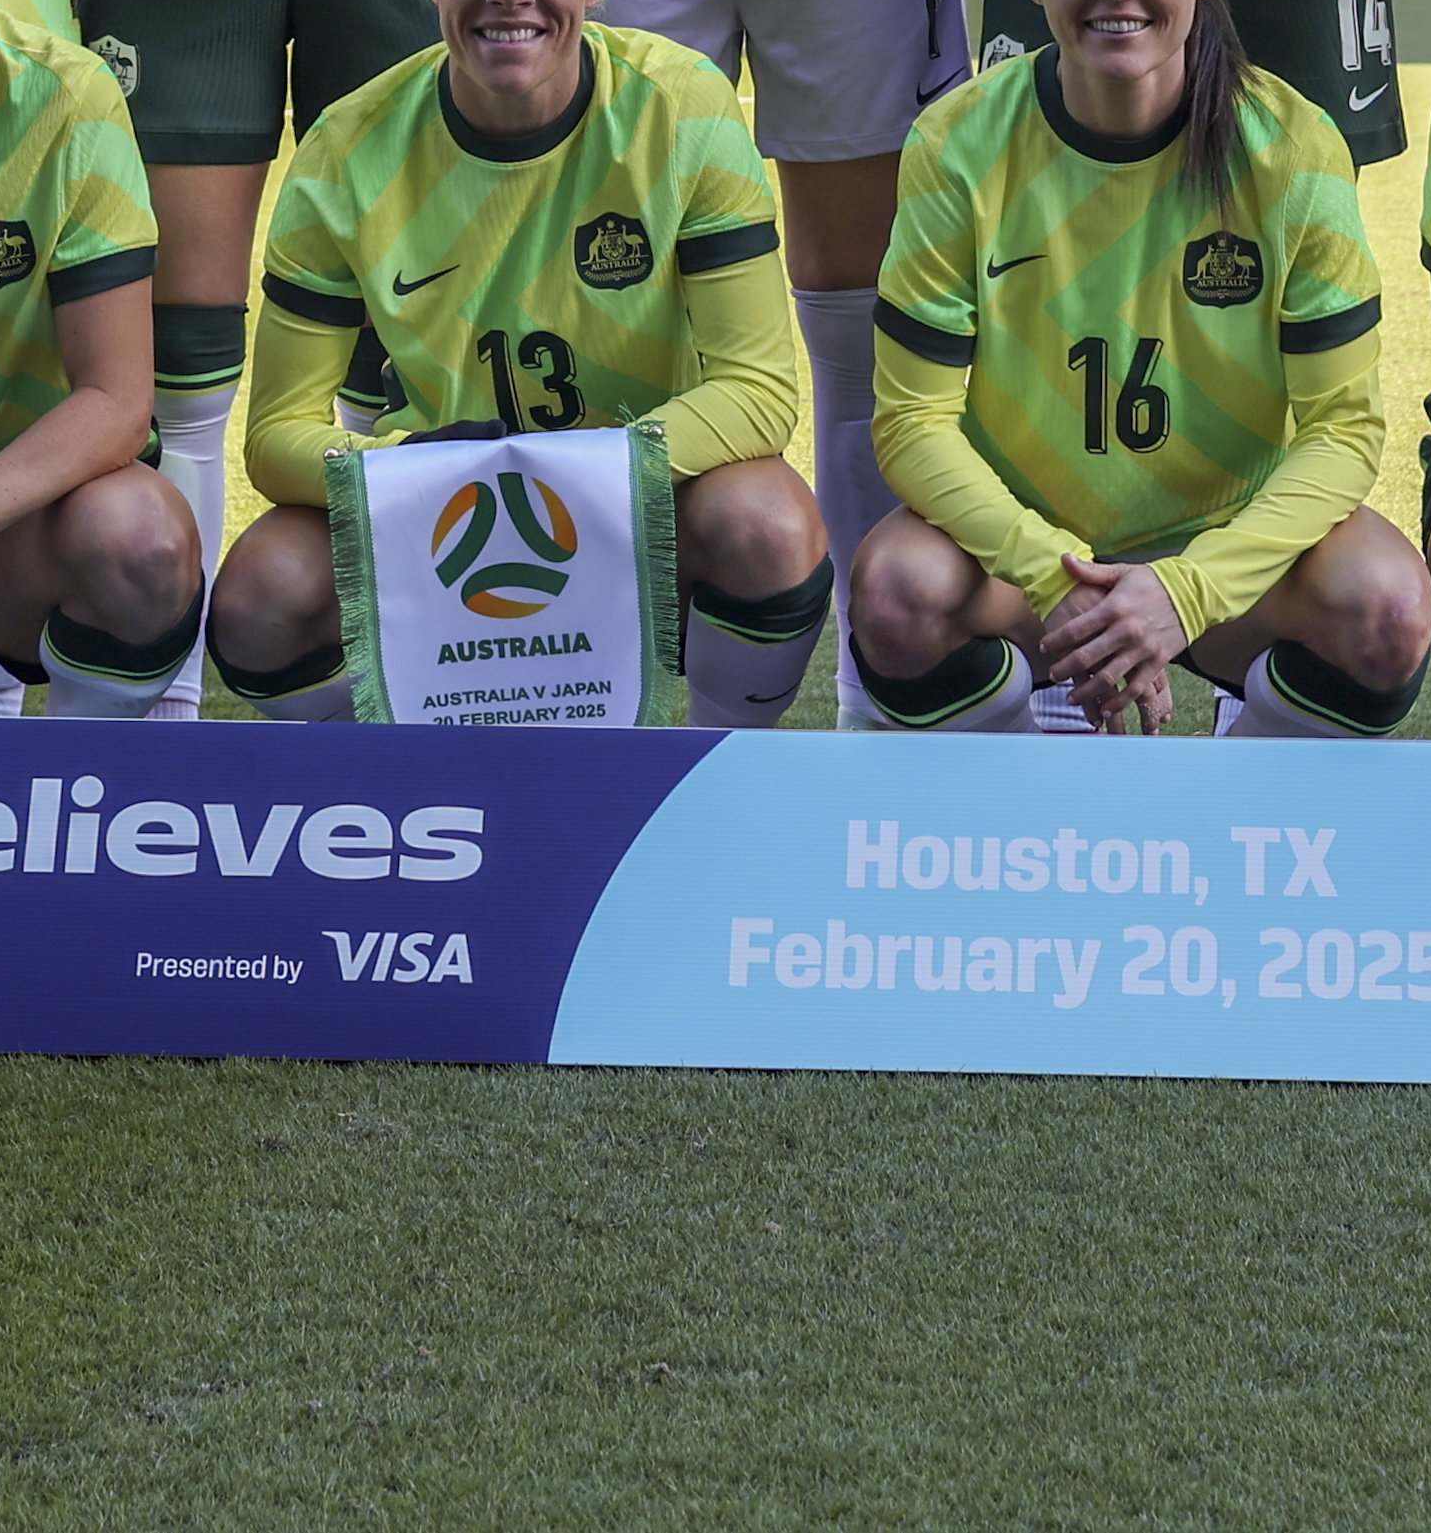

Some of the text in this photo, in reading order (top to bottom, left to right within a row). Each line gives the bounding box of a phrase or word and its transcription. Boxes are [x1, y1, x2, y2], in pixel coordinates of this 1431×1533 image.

[591, 258, 641, 271] AUSTRALIA
[1196, 279, 1249, 288] AUSTRALIA
[477, 329, 586, 436] 13
[1069, 337, 1170, 455] 16
[437, 632, 593, 665] AUSTRALIA
[423, 680, 612, 709] AUSTRALIA V JAPAN
[459, 707, 561, 726] FEBRUARY
[566, 704, 606, 719] 2025
[844, 819, 1338, 906] Houston, TX
[135, 931, 474, 984] Presented by VISA
[728, 917, 1102, 1008] February
[1121, 924, 1238, 1008] 20,
